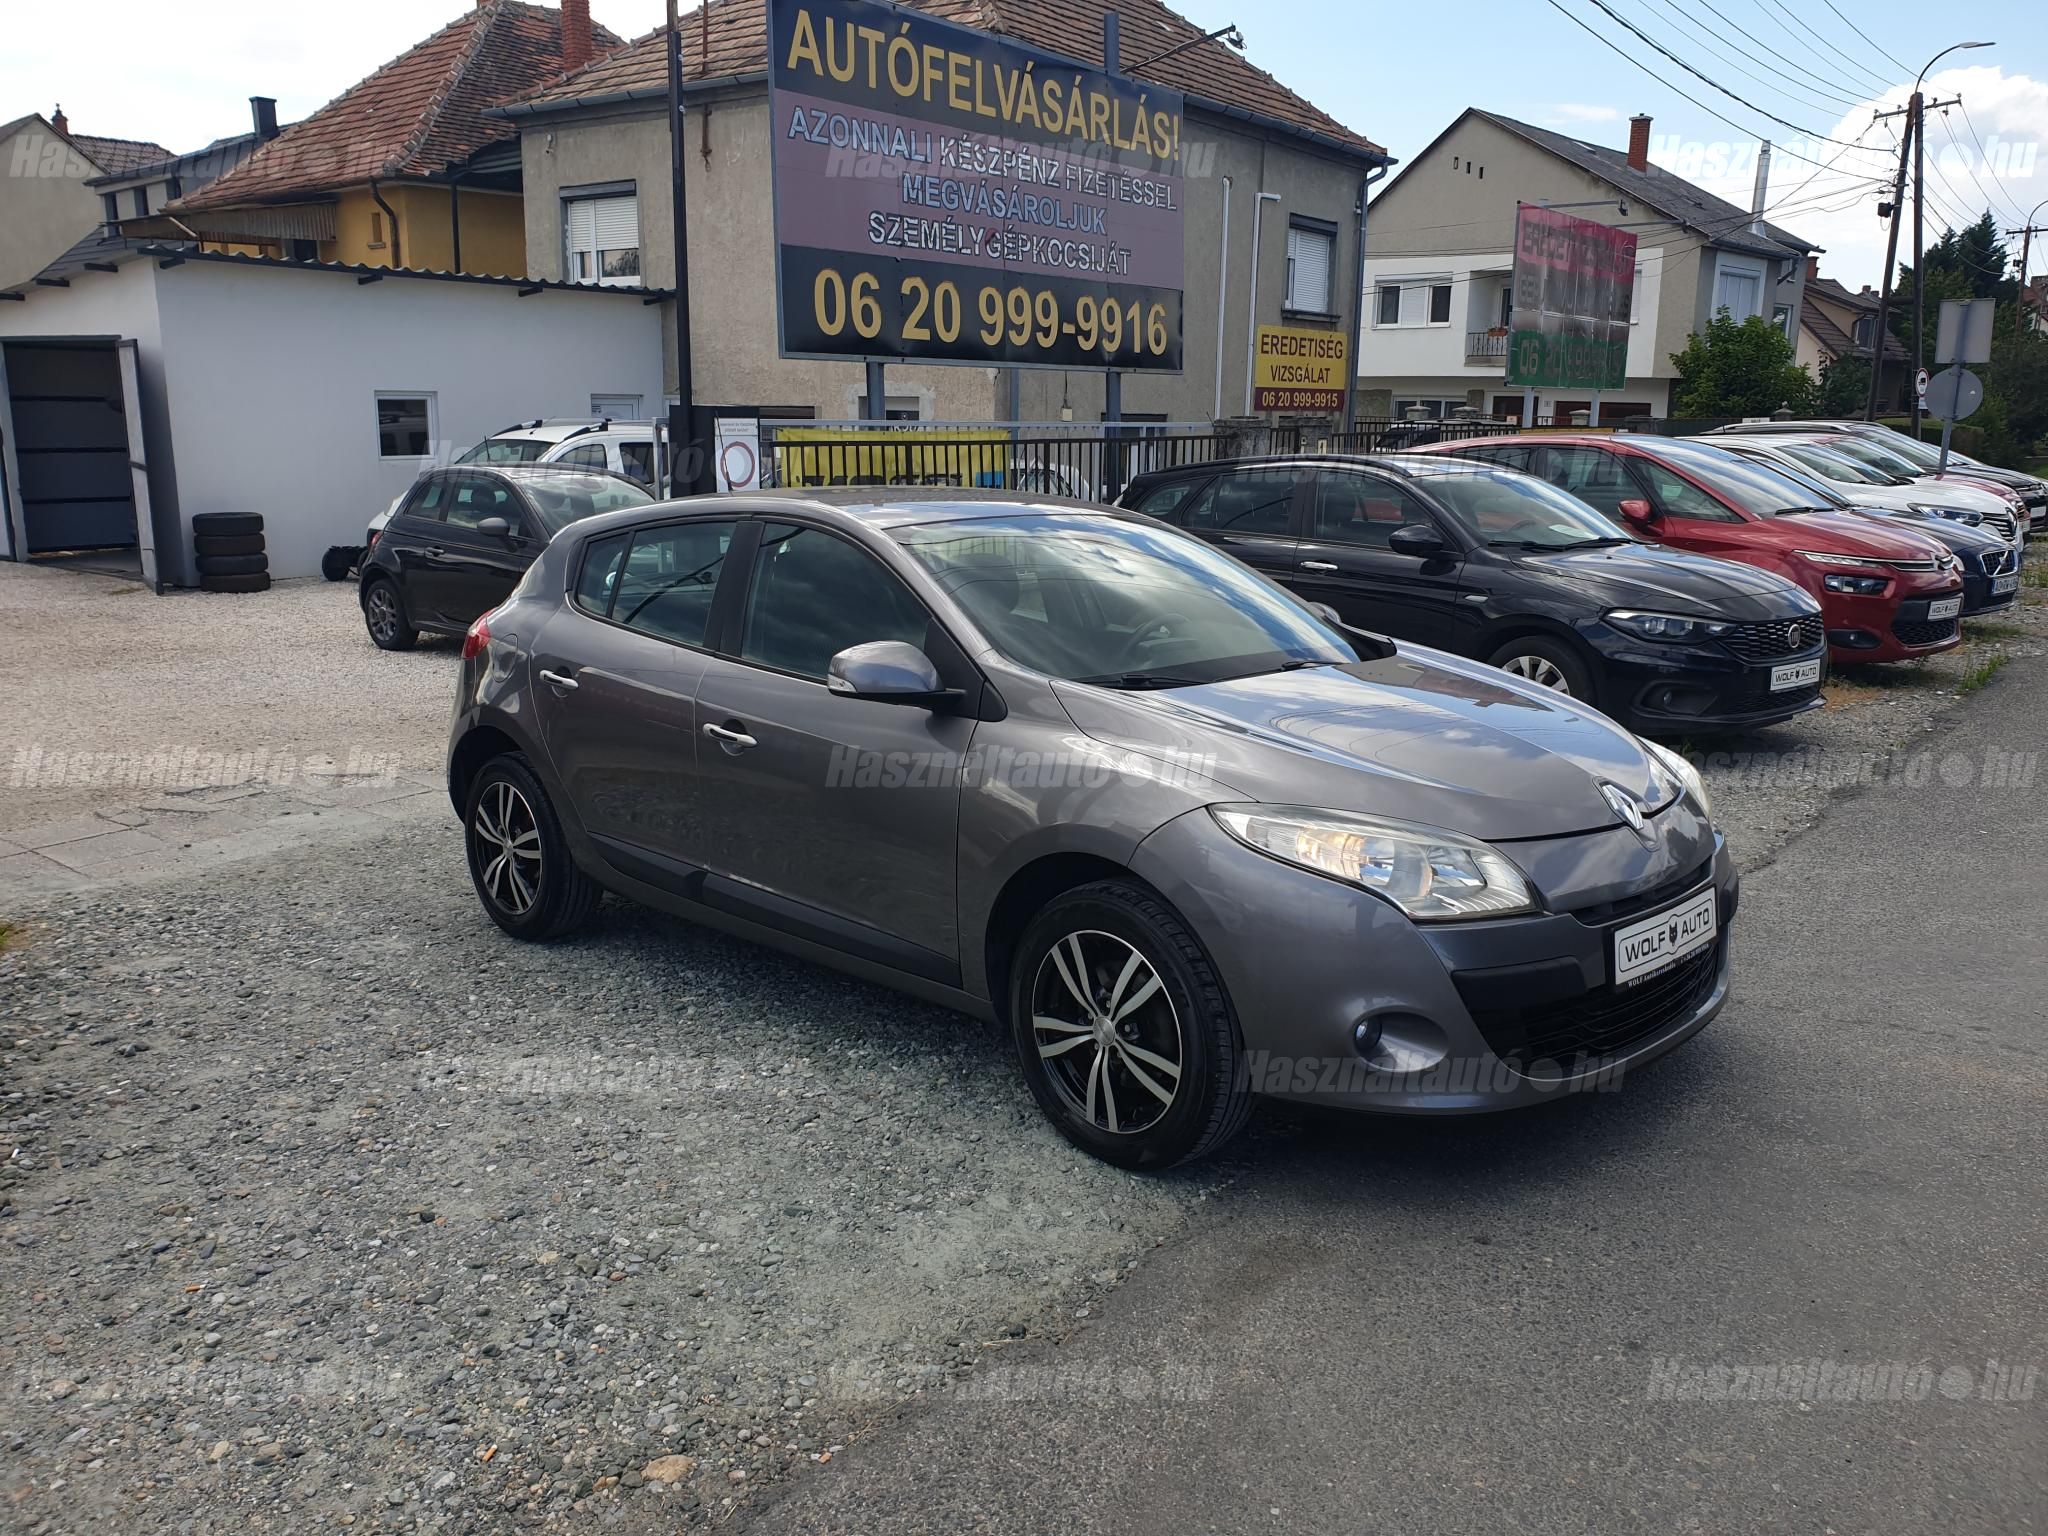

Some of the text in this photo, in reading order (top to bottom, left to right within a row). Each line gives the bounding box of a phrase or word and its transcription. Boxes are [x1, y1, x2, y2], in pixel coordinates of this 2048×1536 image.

[787, 9, 1180, 161] AUTÓFELVÁSÁRLÁS!
[788, 105, 1178, 211] AZONNALI KÉSZPÉNZ FIZETÉSSEL
[902, 171, 1108, 235] MEGVÁSÁROLJUK
[813, 268, 1168, 357] 06 20 999-9916
[1260, 334, 1343, 360] EREDETISÉG
[1270, 363, 1330, 383] VIZSGÁLAT
[1262, 391, 1338, 407] 06 20 999-9915
[1775, 666, 1817, 682] WOLF AUTO
[1625, 930, 1666, 963] WOLF
[1681, 907, 1710, 939] AUTO
